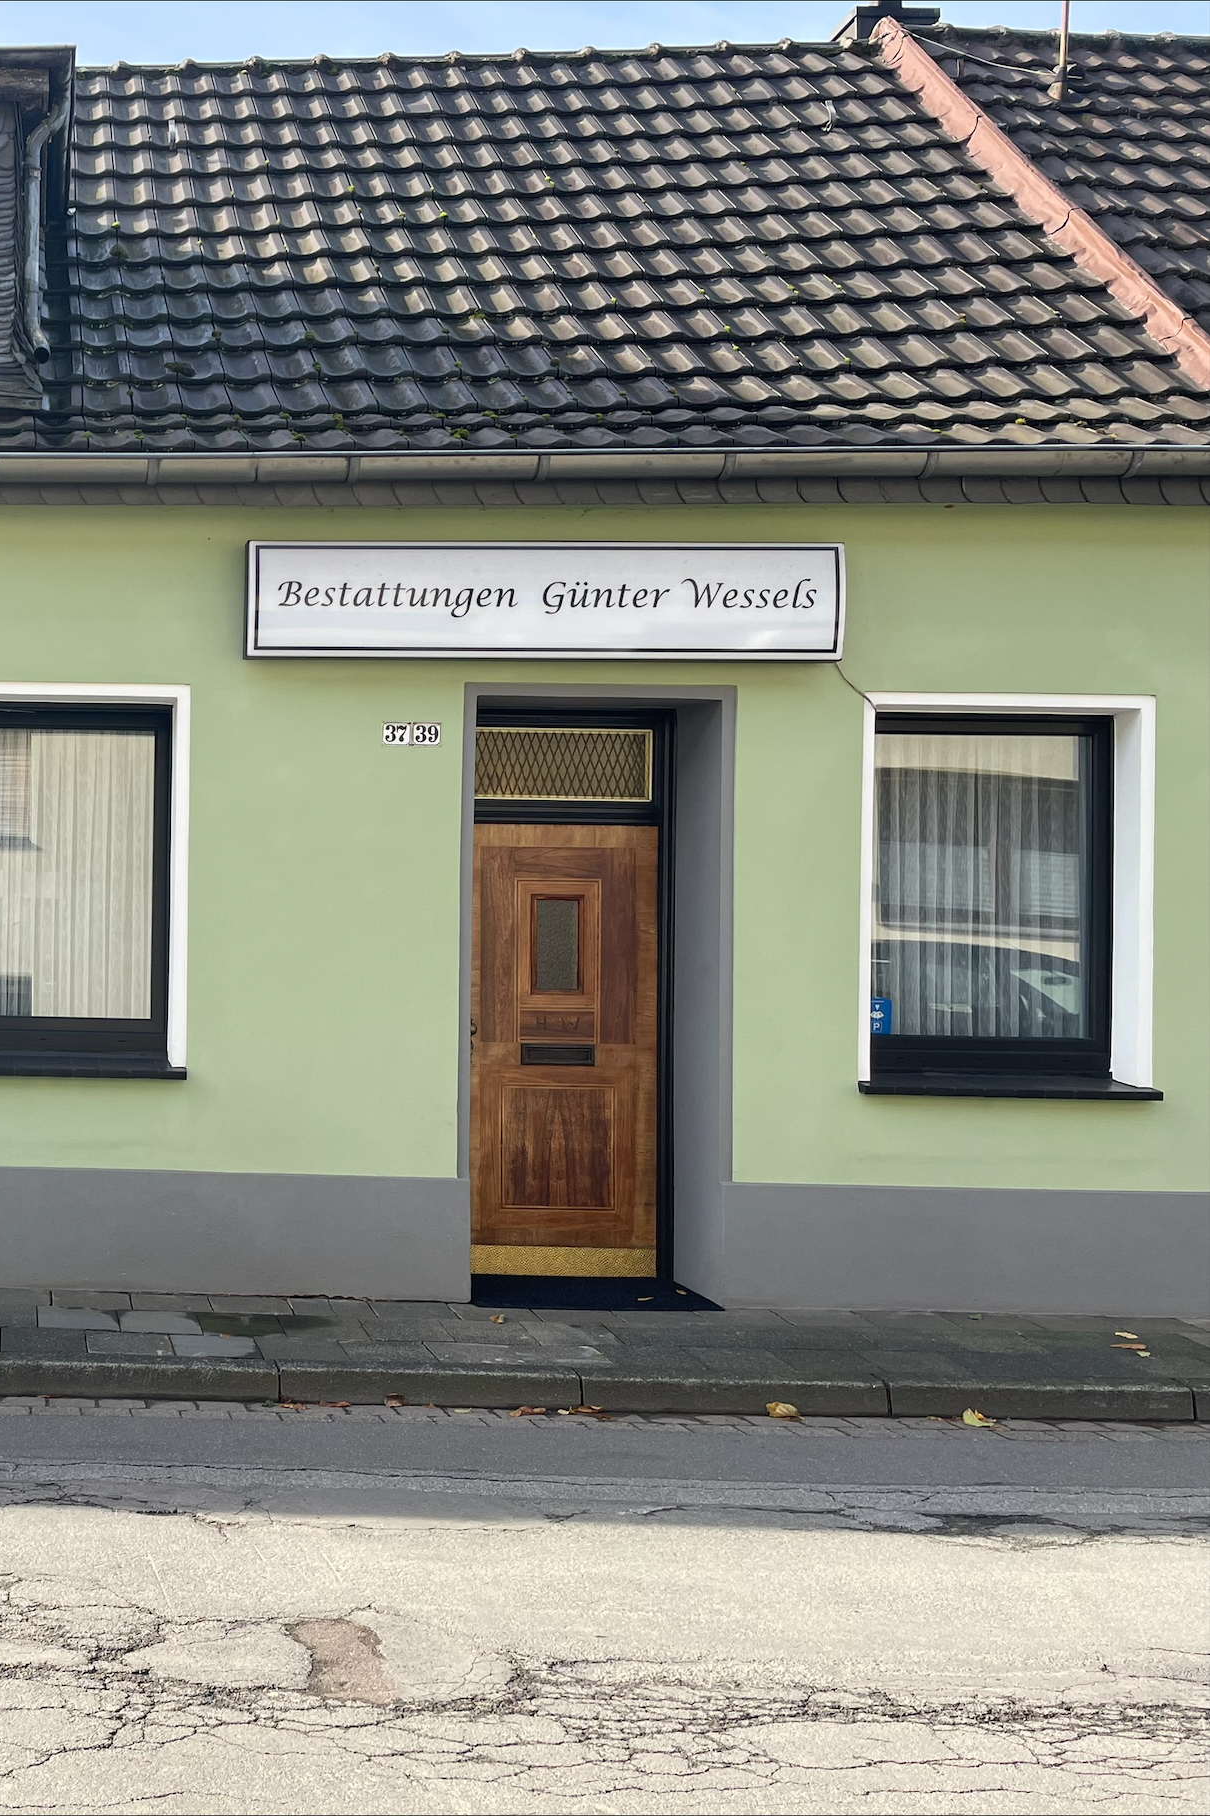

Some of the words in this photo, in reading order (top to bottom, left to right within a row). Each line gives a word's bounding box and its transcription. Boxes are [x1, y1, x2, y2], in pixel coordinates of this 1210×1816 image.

[277, 580, 519, 618] Bestattungen
[541, 581, 671, 615] Günter
[680, 578, 817, 609] Wessels
[385, 724, 408, 743] 37
[415, 724, 439, 743] 39
[873, 1022, 881, 1031] P
